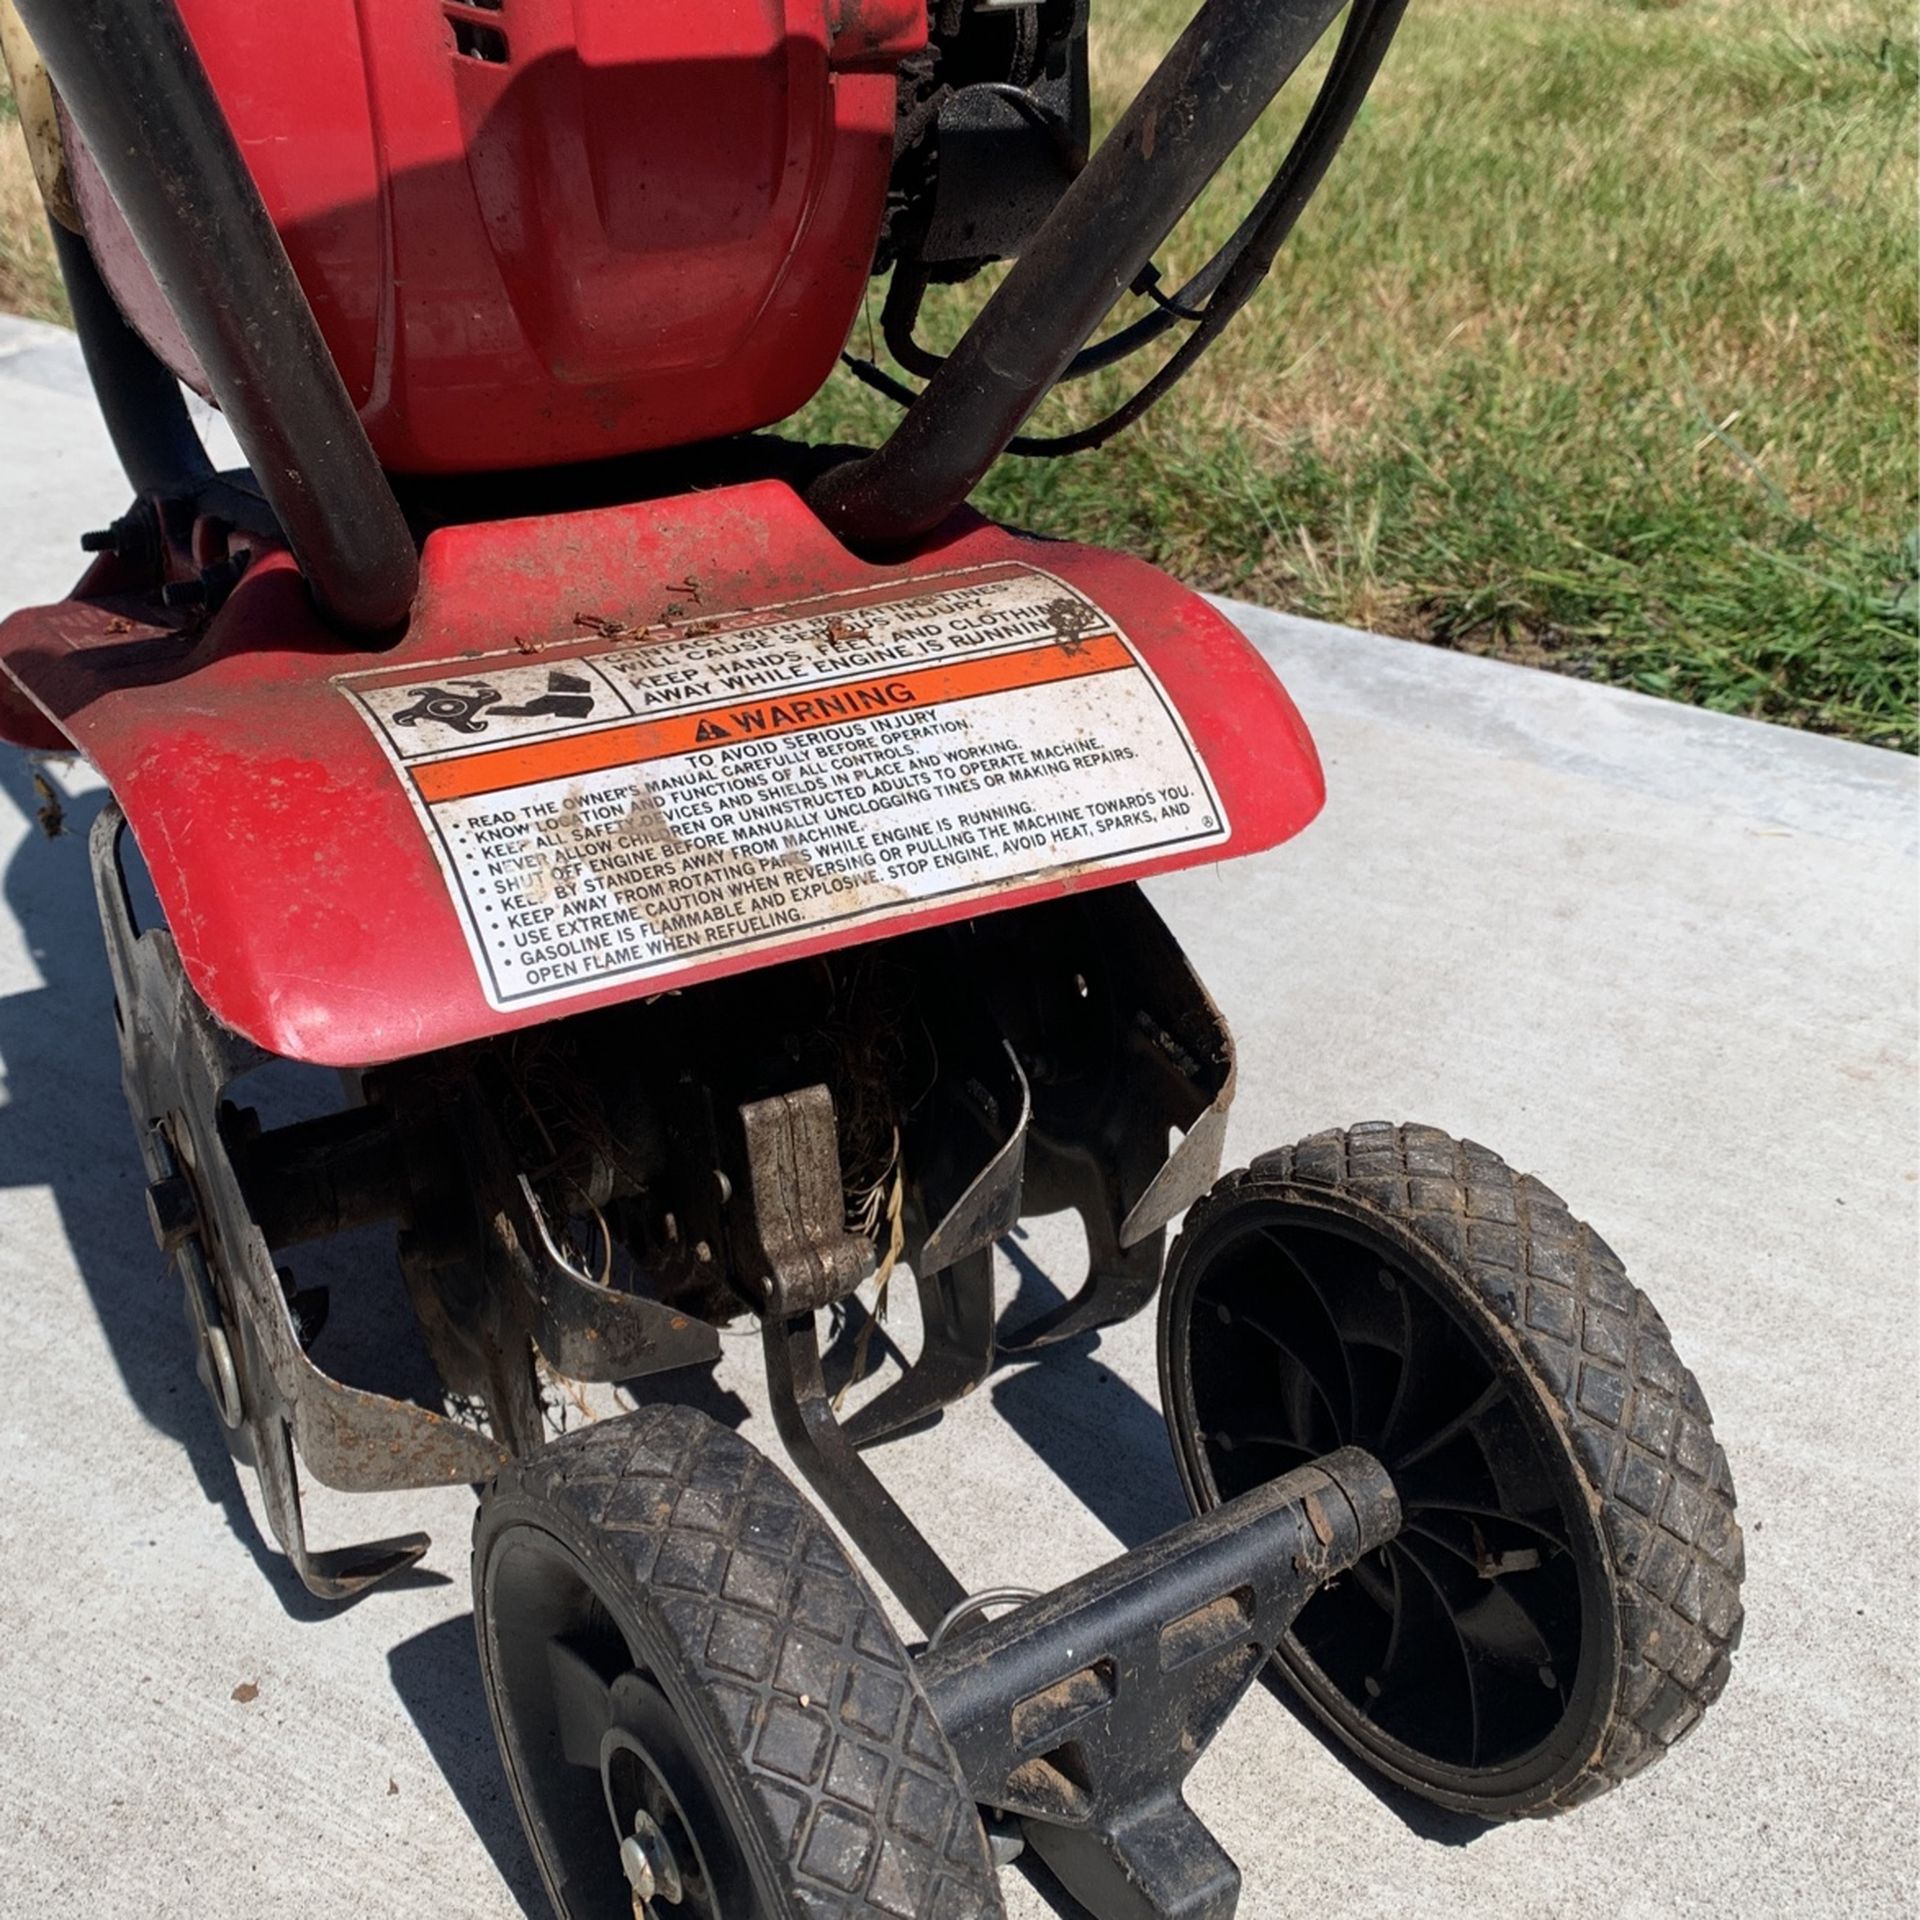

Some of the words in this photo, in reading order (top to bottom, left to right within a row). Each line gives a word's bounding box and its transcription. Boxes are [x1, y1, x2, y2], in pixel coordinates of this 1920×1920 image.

[612, 653, 678, 673] WILL
[687, 637, 774, 661] CAUSE
[896, 598, 990, 622] INJURY.
[629, 668, 698, 689] KEEP
[707, 651, 811, 675] HANDS,
[891, 624, 941, 646] AND
[949, 603, 1056, 631] CLOTHIN
[644, 681, 717, 705] AWAY
[720, 668, 809, 689] WHILE
[813, 644, 913, 674] ENGINE
[923, 639, 944, 652] IS
[949, 618, 1051, 647] RUNNIN
[733, 621, 798, 641] WITH
[686, 754, 713, 768] TO
[721, 741, 777, 762] AVOID
[782, 724, 866, 749] SERIOUS
[871, 709, 937, 731] INJURY
[729, 683, 916, 732] WARNING
[468, 812, 515, 828] READ
[520, 802, 558, 818] THE
[562, 785, 639, 809] OWNER'S
[644, 770, 717, 793] MANUAL
[722, 751, 810, 776] CAREFULLY
[815, 737, 877, 757] BEFORE
[881, 719, 973, 745] OPERATION.
[475, 824, 529, 843] KNOW
[536, 805, 624, 831] LOCATION
[630, 796, 665, 812] AND
[670, 775, 767, 803] FUNCTIONS
[772, 769, 791, 781] OF
[799, 763, 827, 776] ALL
[831, 744, 919, 769] CONTROLS.
[536, 834, 567, 847] ALL
[719, 793, 752, 810] AND
[758, 777, 827, 800] SHIELDS
[832, 773, 849, 785] IN
[854, 761, 903, 781] PLACE
[908, 756, 940, 769] AND
[943, 739, 1022, 762] WORKING.
[551, 864, 582, 880] OFF
[589, 850, 657, 871] ENGINE
[661, 831, 728, 857] BEFORE
[733, 813, 819, 840] MANUALLY
[824, 789, 931, 820] UNCLOGGING
[933, 780, 980, 798] TINES
[984, 774, 1006, 787] OR
[1008, 760, 1070, 782] MAKING
[1074, 747, 1138, 768] REPAIRS.
[555, 840, 612, 863] ALLOW
[711, 813, 733, 827] OR
[739, 785, 866, 821] UNINSTRUCTED
[872, 772, 931, 795] ADULTS
[933, 767, 956, 781] TO
[960, 753, 1029, 776] OPERATE
[1031, 737, 1104, 762] MACHINE.
[507, 907, 554, 929] KEEP
[563, 896, 608, 916] AWAY
[614, 885, 664, 904] FROM
[670, 862, 756, 892] ROTATING
[815, 836, 869, 858] WHILE
[871, 821, 935, 845] ENGINE
[937, 818, 950, 831] IS
[957, 801, 1036, 826] RUNNING.
[514, 929, 551, 948] USE
[556, 907, 641, 937] EXTREME
[645, 888, 724, 917] CAUTION
[727, 875, 780, 897] WHEN
[783, 853, 876, 884] REVERSING
[879, 847, 902, 862] OR
[907, 832, 975, 855] PULLING
[980, 823, 1011, 840] THE
[1013, 807, 1082, 833] MACHINE
[1085, 793, 1156, 816] TOWARDS
[1158, 785, 1194, 801] YOU.
[520, 936, 612, 966] GASOLINE
[617, 929, 635, 941] IS
[640, 902, 746, 937] FLAMMABLE
[751, 894, 785, 911] AND
[790, 869, 883, 902] EXPLOSIVE.
[886, 858, 929, 879] STOP
[932, 843, 999, 869] ENGINE,
[1002, 833, 1046, 855] AVOID
[1049, 823, 1094, 844] HEAT,
[1097, 809, 1158, 833] SPARKS,
[1160, 802, 1191, 819] AND
[554, 885, 577, 899] BY
[583, 863, 676, 892] STANDERS
[682, 850, 724, 871] AWAY
[731, 839, 779, 859] FROM
[782, 821, 865, 849] MACHINE.
[526, 962, 578, 985] OPEN
[582, 945, 642, 971] FLAME
[646, 931, 700, 955] WHEN
[704, 908, 806, 941] REFUELING.
